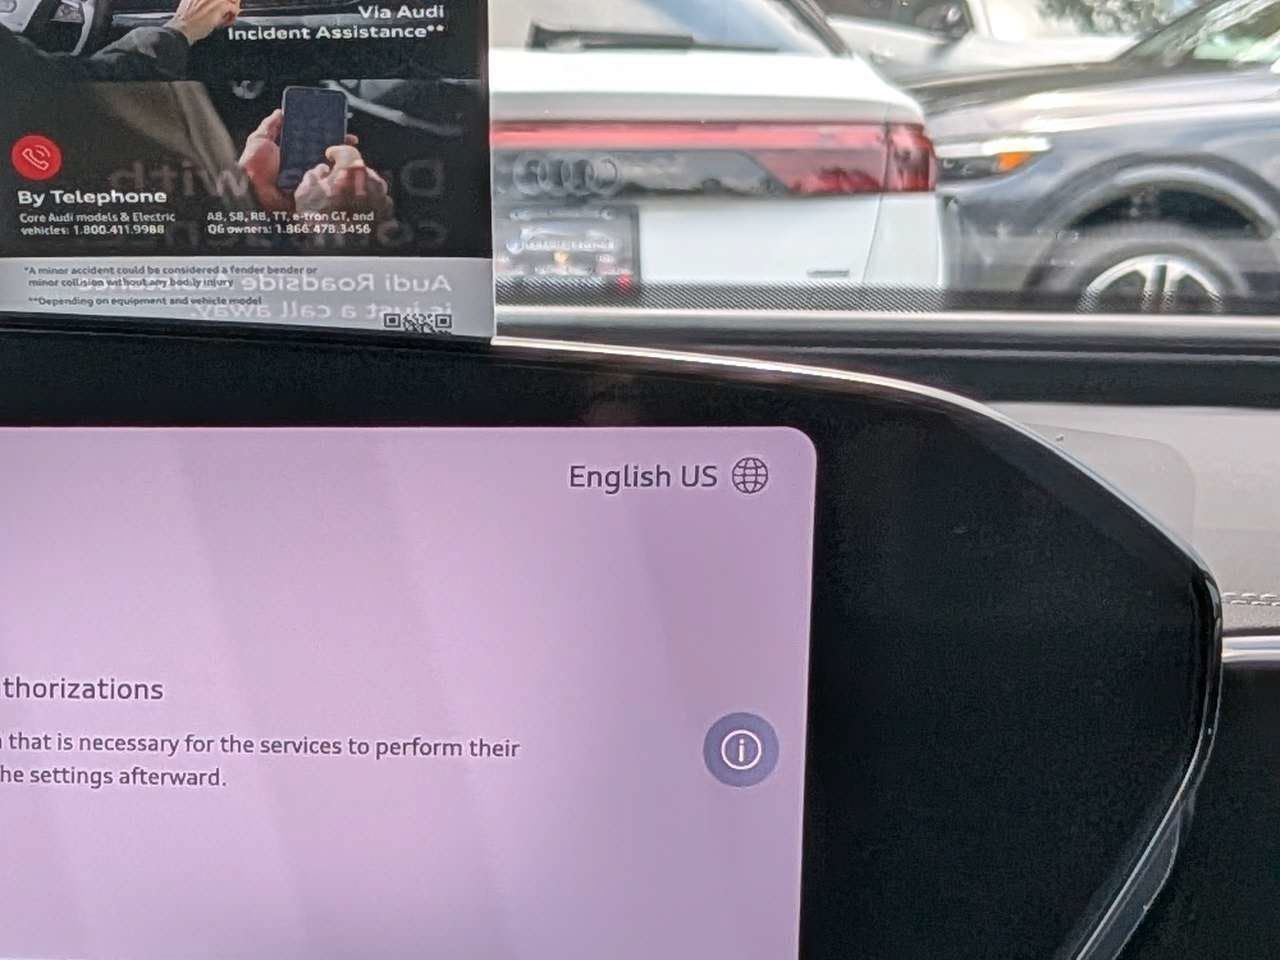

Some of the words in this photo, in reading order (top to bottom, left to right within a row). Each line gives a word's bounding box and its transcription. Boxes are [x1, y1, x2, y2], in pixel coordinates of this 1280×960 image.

[358, 5, 392, 19] Via
[397, 4, 445, 19] Audi
[227, 26, 312, 41] Incident
[17, 189, 45, 208] By
[50, 188, 168, 207] Telephone
[19, 212, 46, 223] Core
[48, 212, 73, 222] Audi
[76, 212, 119, 223] models
[120, 212, 130, 222] &
[132, 211, 176, 223] Electric
[20, 224, 70, 236] vehicles:
[38, 266, 69, 275] minor
[71, 265, 116, 275] accident
[116, 265, 146, 275] could
[147, 265, 161, 275] be
[162, 264, 220, 275] considered
[221, 266, 229, 275] a
[230, 263, 266, 275] fender
[266, 264, 305, 275] bender
[306, 266, 318, 275] or
[95, 296, 110, 305] on
[110, 295, 168, 307] equipment
[169, 295, 189, 305] and
[189, 295, 228, 305] vehicle
[228, 294, 262, 305] model
[569, 463, 671, 495] English
[680, 464, 718, 488] US
[8, 731, 52, 752] that
[57, 732, 73, 753] is
[78, 734, 180, 757] necessary
[184, 732, 215, 754] for
[219, 734, 255, 755] the
[259, 735, 343, 756] services
[347, 737, 370, 756] to
[374, 736, 463, 761] perform
[468, 737, 521, 758] their
[29, 765, 114, 790] settings
[118, 766, 228, 788] afterward.
